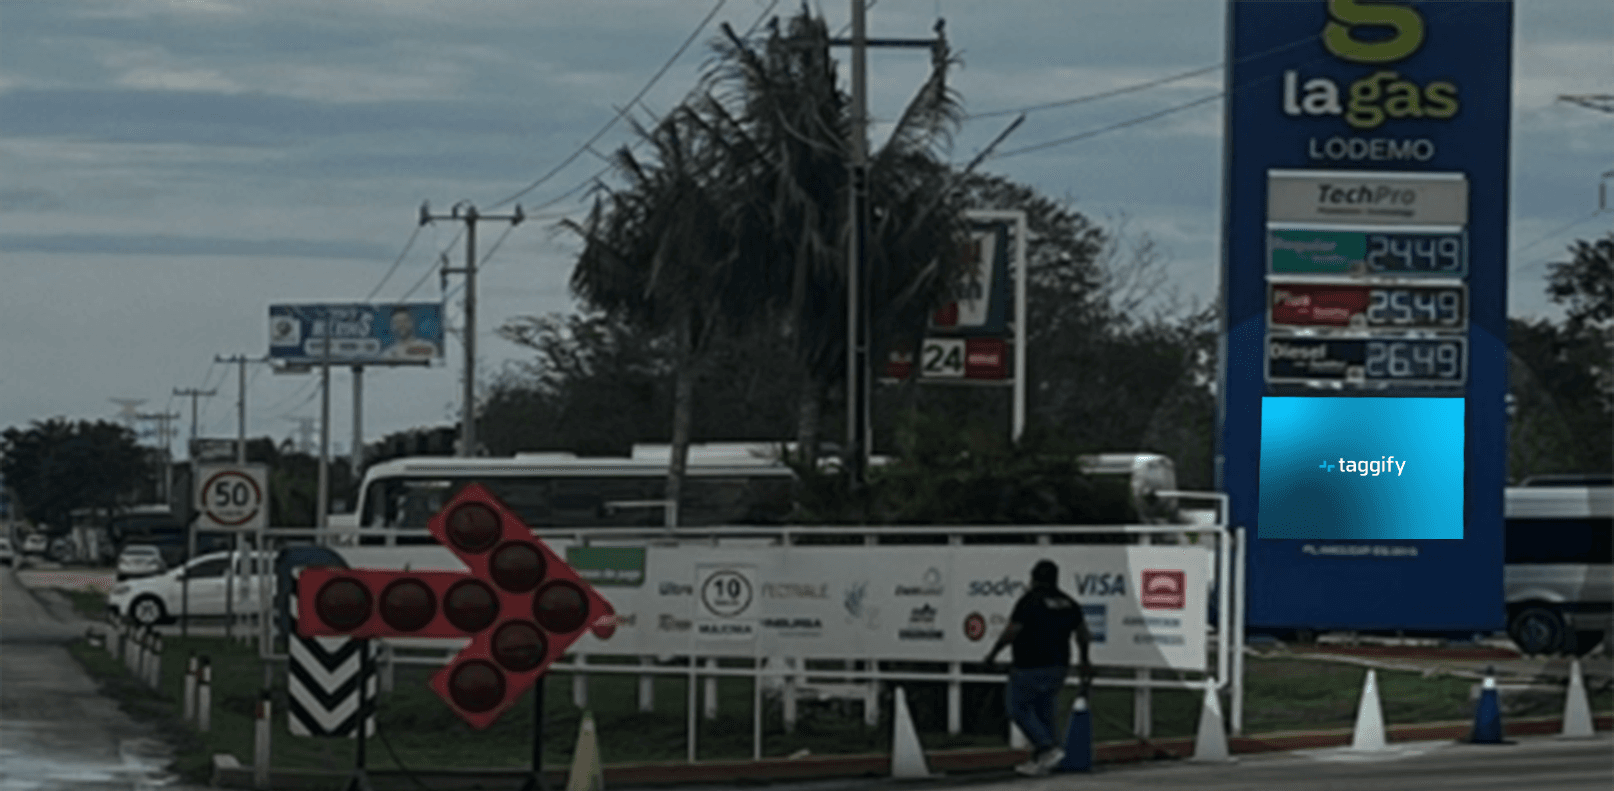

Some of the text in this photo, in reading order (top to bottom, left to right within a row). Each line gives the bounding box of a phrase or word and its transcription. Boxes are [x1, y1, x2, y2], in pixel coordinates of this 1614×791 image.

[1309, 138, 1434, 160] LODEMO
[1318, 184, 1416, 205] TechPro
[925, 345, 960, 371] 24
[1338, 456, 1406, 476] taggify
[216, 482, 249, 507] 50
[714, 579, 741, 599] 10
[1075, 573, 1126, 596] VISA
